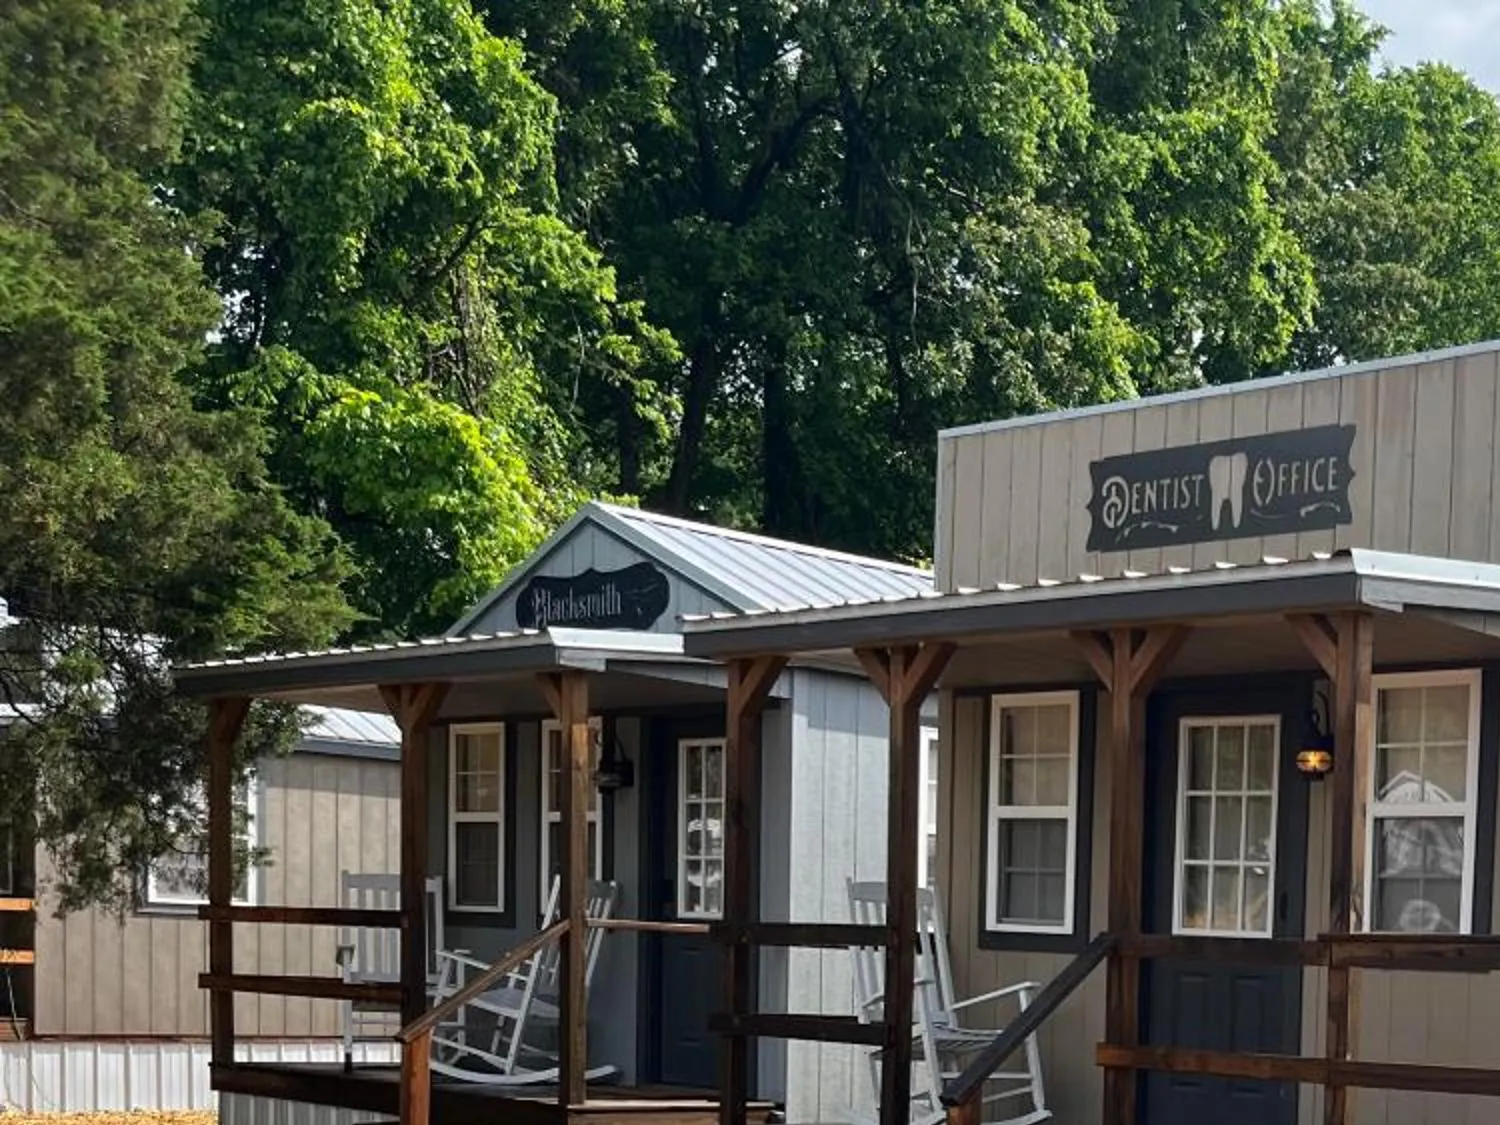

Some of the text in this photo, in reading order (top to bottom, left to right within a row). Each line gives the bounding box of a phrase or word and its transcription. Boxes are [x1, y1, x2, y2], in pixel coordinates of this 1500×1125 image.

[1101, 455, 1339, 529] DENTIST OFFICE
[531, 581, 622, 629] Blacksmith
